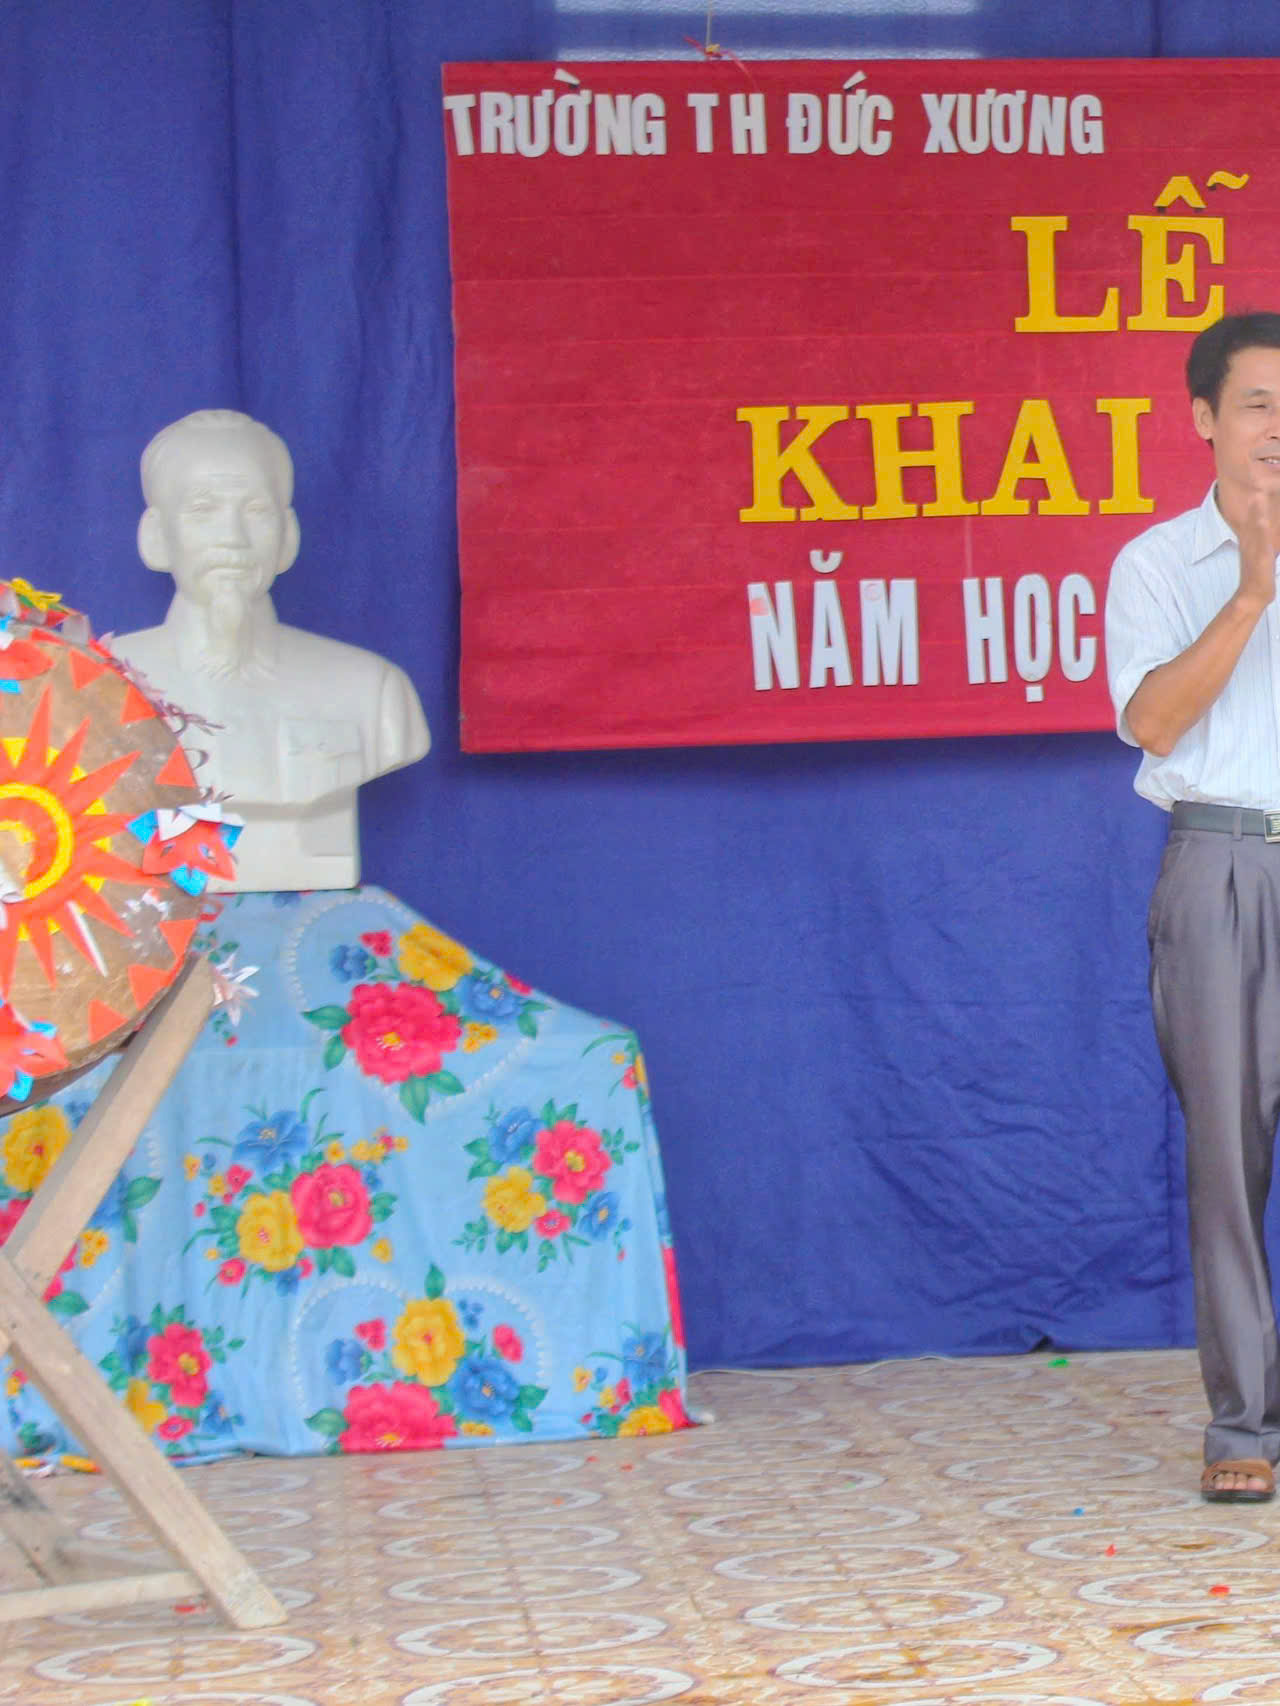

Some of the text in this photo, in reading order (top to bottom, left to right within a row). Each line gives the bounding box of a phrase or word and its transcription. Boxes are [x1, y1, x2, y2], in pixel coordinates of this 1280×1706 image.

[443, 68, 667, 158] TRƯỜNG
[786, 70, 894, 156] ĐỨC
[922, 87, 1105, 156] XƯƠNG
[1012, 171, 1249, 333] LỄ
[736, 398, 1155, 523] KHAI
[748, 550, 920, 691] NĂM
[963, 573, 1097, 702] HỌC
